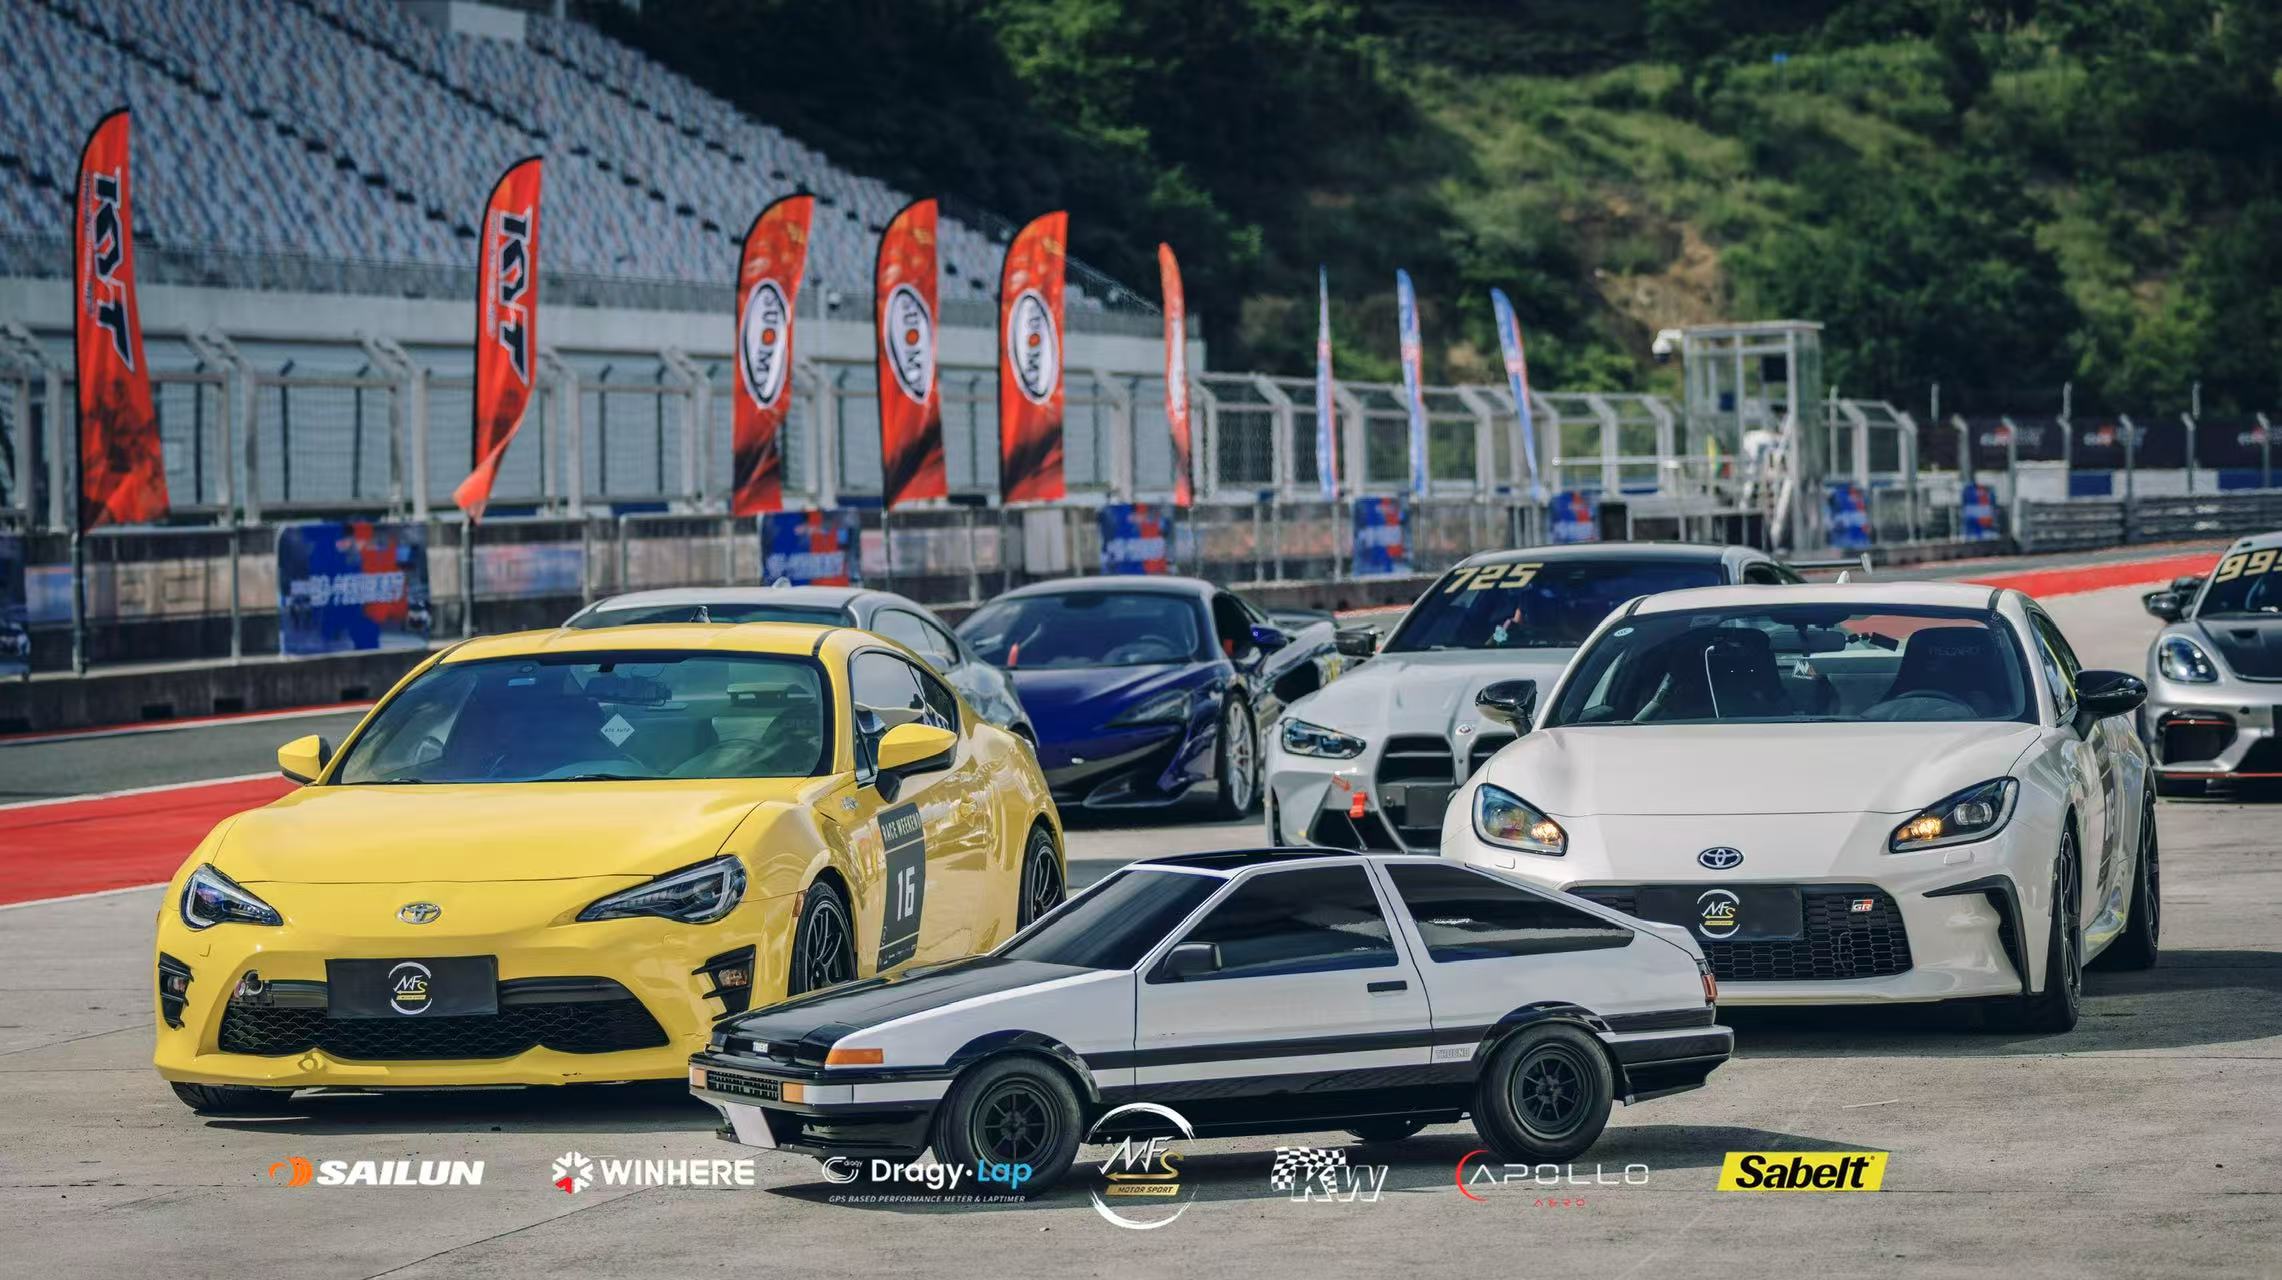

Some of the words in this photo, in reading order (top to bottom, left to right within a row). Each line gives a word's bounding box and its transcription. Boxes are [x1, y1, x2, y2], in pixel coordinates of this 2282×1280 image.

[93, 166, 135, 373] KYT
[499, 205, 532, 386] KYT
[1443, 563, 1544, 594] 725
[881, 820, 898, 842] RACE
[897, 866, 915, 921] 16
